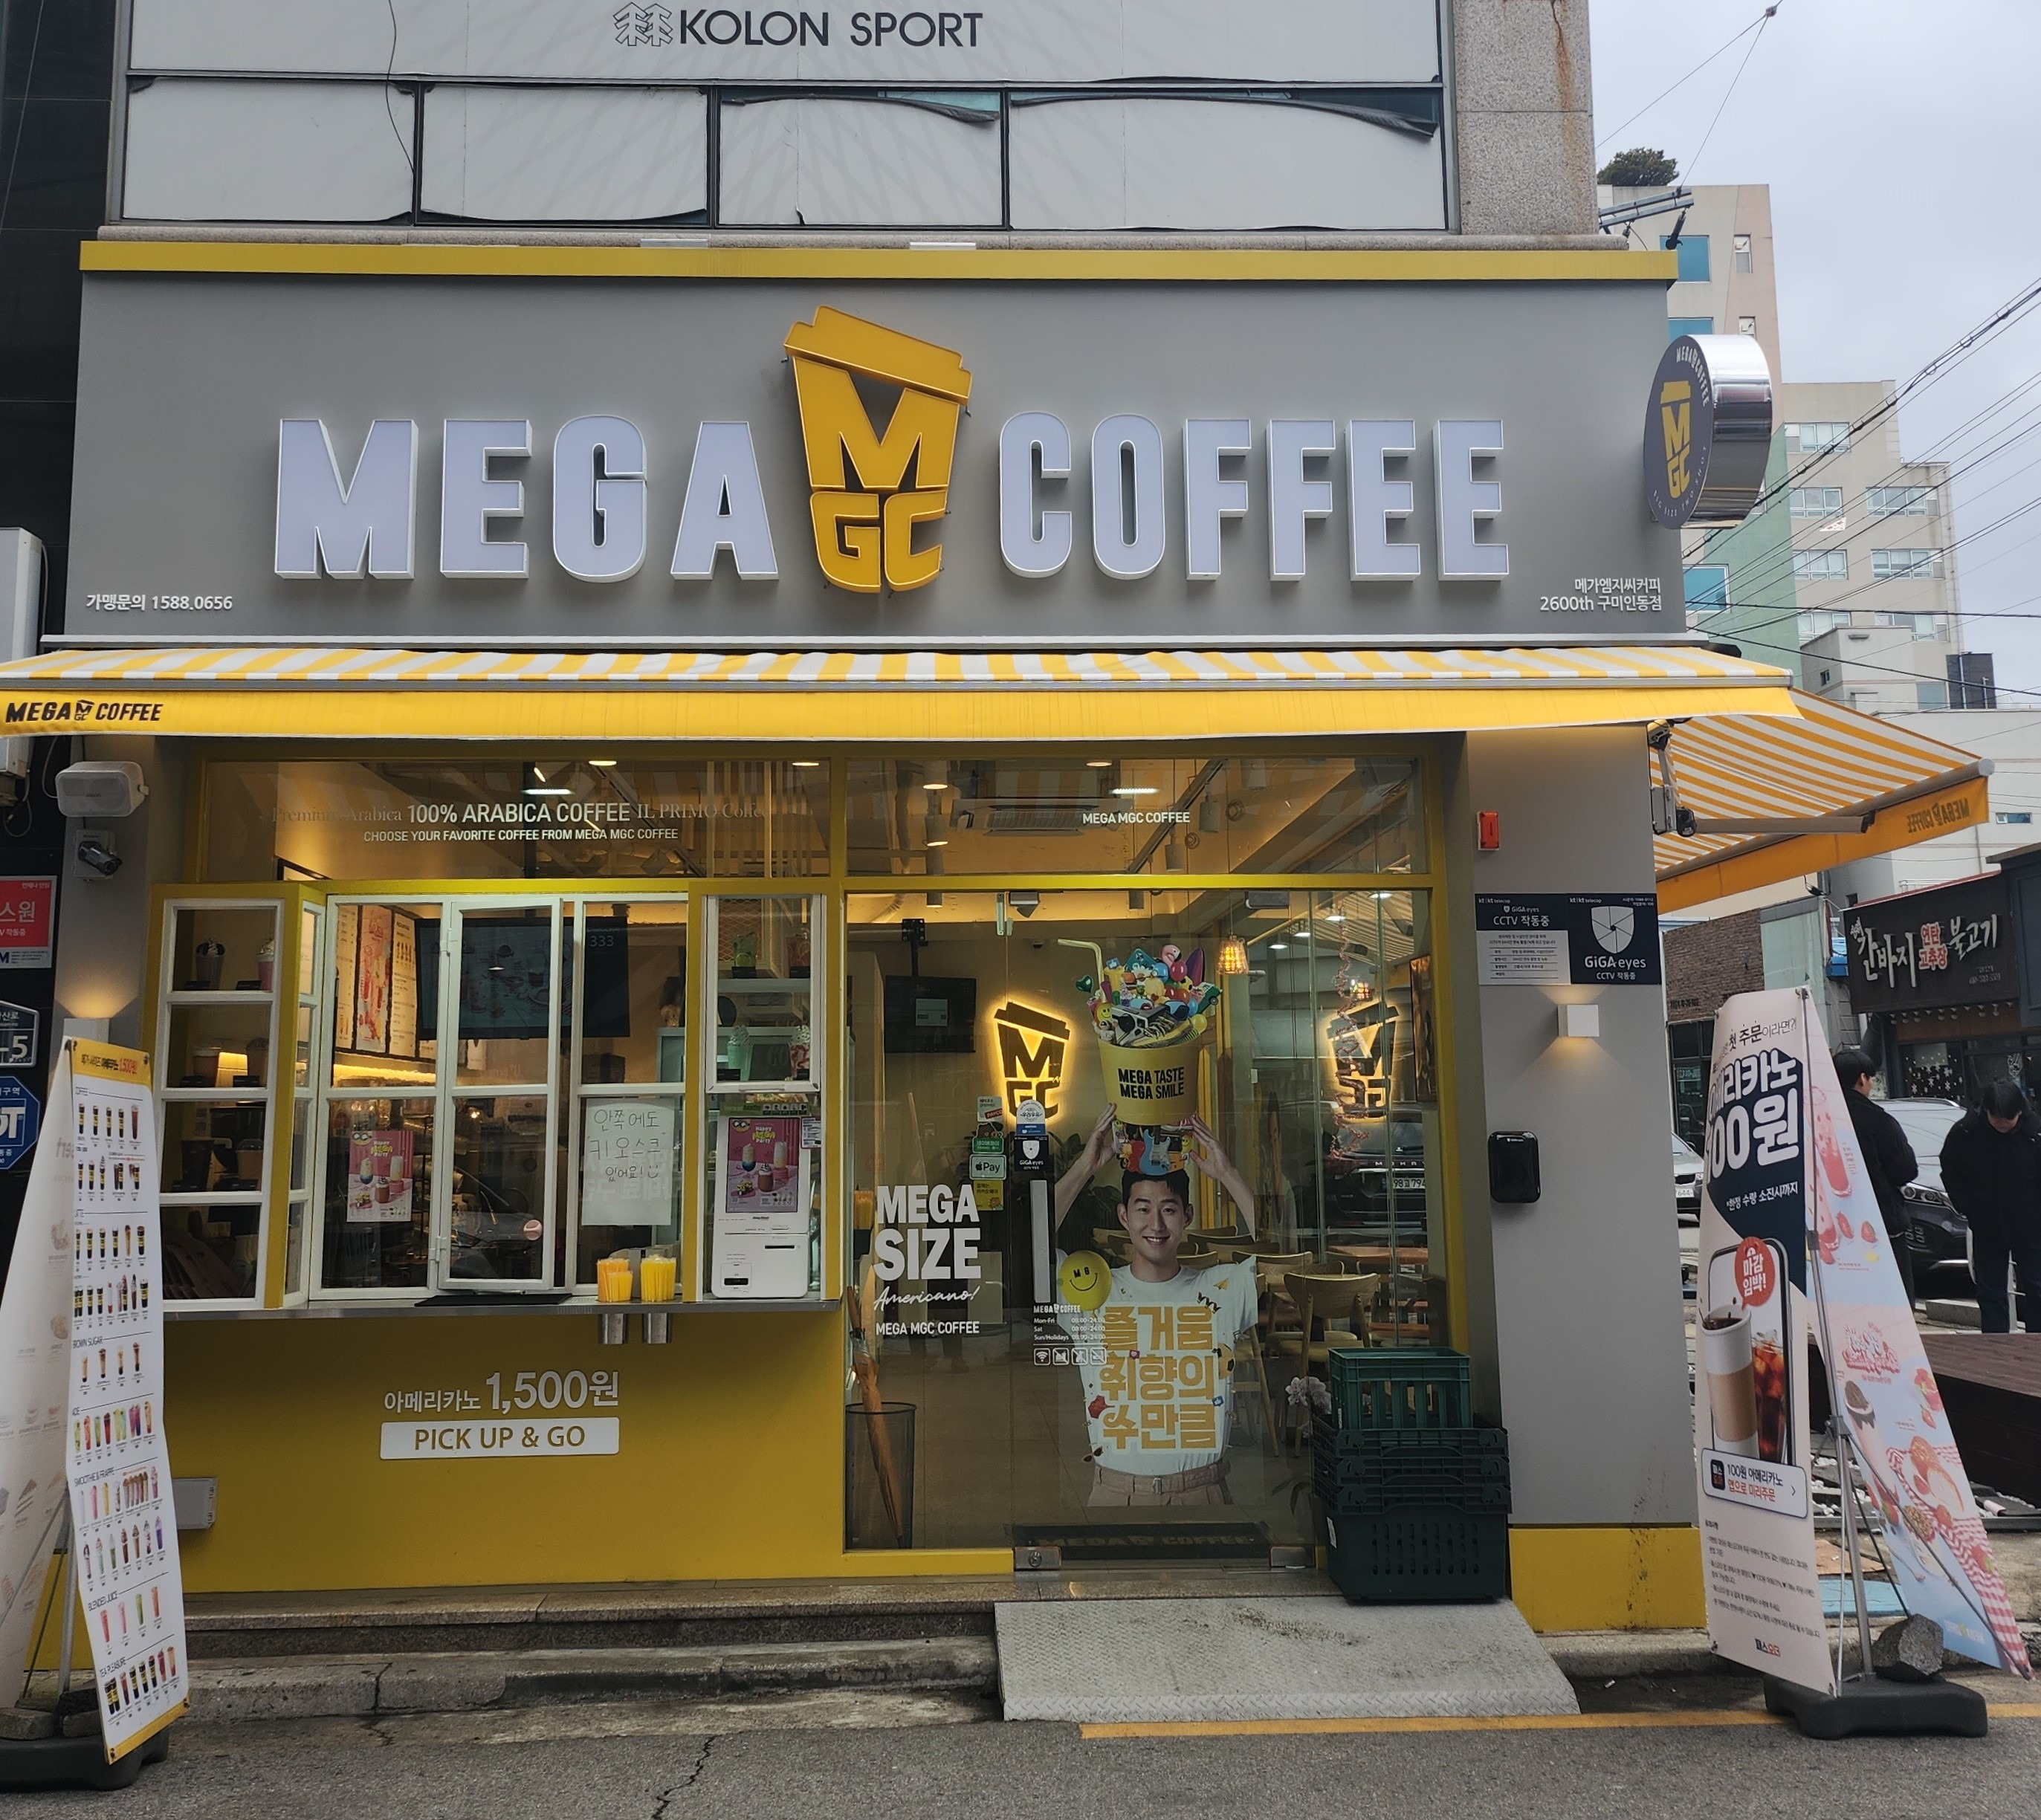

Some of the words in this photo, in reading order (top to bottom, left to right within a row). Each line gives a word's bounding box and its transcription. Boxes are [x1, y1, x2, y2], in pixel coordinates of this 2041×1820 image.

[680, 9, 829, 46] KOLON
[850, 12, 983, 47] SPORT
[1695, 445, 1707, 485] SHOT
[274, 415, 779, 583] MEGA
[999, 411, 1509, 580] COFFEE
[1574, 577, 1661, 594] 메가엠지씨커피
[85, 594, 146, 611] 가맹문의
[151, 595, 233, 610] 1588.0656
[1540, 596, 1594, 611] 2600th
[1597, 595, 1662, 612] 구미인동점
[5, 702, 71, 723] MEGA
[95, 703, 164, 722] COFFEE
[408, 803, 457, 823] 100%
[462, 803, 552, 823] ARABICA
[557, 802, 631, 823] COFFEE
[637, 803, 657, 819] IL
[659, 803, 717, 819] PRIMO
[1082, 812, 1116, 824] MEGA
[1118, 812, 1144, 823] MGC
[1145, 812, 1191, 823] COFFEE
[363, 830, 409, 842] CHOOSE
[411, 830, 441, 841] YOUR
[443, 829, 495, 841] FAVORITE
[498, 829, 539, 841] COFFEE
[542, 829, 572, 841] FROM
[575, 829, 607, 840] MEGA
[609, 828, 635, 840] MGC
[637, 828, 678, 839] COFFEE
[0, 900, 36, 922] 스원
[1492, 916, 1518, 926] CCTV
[1521, 915, 1550, 927] 작동중
[589, 935, 615, 948] 333
[1857, 927, 1918, 988] 간바지
[1949, 913, 1997, 961] 불고기
[1584, 956, 1617, 968] GiGA
[1617, 958, 1646, 971] eyes
[1919, 944, 1948, 971] 고추장
[1596, 971, 1615, 980] CCTV
[1617, 971, 1636, 980] 작동중
[0, 1011, 19, 1020] 산로
[1117, 1067, 1153, 1084] MEGA
[1154, 1066, 1185, 1084] TASTE
[0, 1087, 21, 1096] 구역
[1119, 1083, 1154, 1100] MEGA
[1155, 1081, 1185, 1099] SMILE
[983, 1162, 1000, 1173] Pay
[876, 1184, 980, 1224] MEGA
[873, 1228, 982, 1281] SIZE
[1742, 1253, 1765, 1277] 마감
[1742, 1272, 1767, 1298] 임박!
[873, 1285, 981, 1312] Americano!
[1033, 1305, 1054, 1314] MEGA
[1059, 1305, 1081, 1314] COFFEE
[876, 1321, 908, 1335] MEGA
[910, 1321, 935, 1335] MGC
[937, 1321, 980, 1335] COFFEE
[1033, 1333, 1069, 1341] Sun/Holidays
[1103, 1306, 1213, 1351] 즐거움
[1099, 1352, 1215, 1401] 취향의
[384, 1388, 482, 1413] 아메리카노
[485, 1370, 620, 1415] 1,500원
[1103, 1403, 1217, 1449] 수만큼
[414, 1427, 473, 1451] PICK
[479, 1426, 514, 1449] UP
[522, 1425, 540, 1448] &
[546, 1425, 586, 1448] GO
[1727, 1463, 1747, 1480] 100원
[1748, 1467, 1784, 1487] 아메리카노
[1727, 1478, 1747, 1495] 앱으로
[1749, 1483, 1776, 1503] 미리주문
